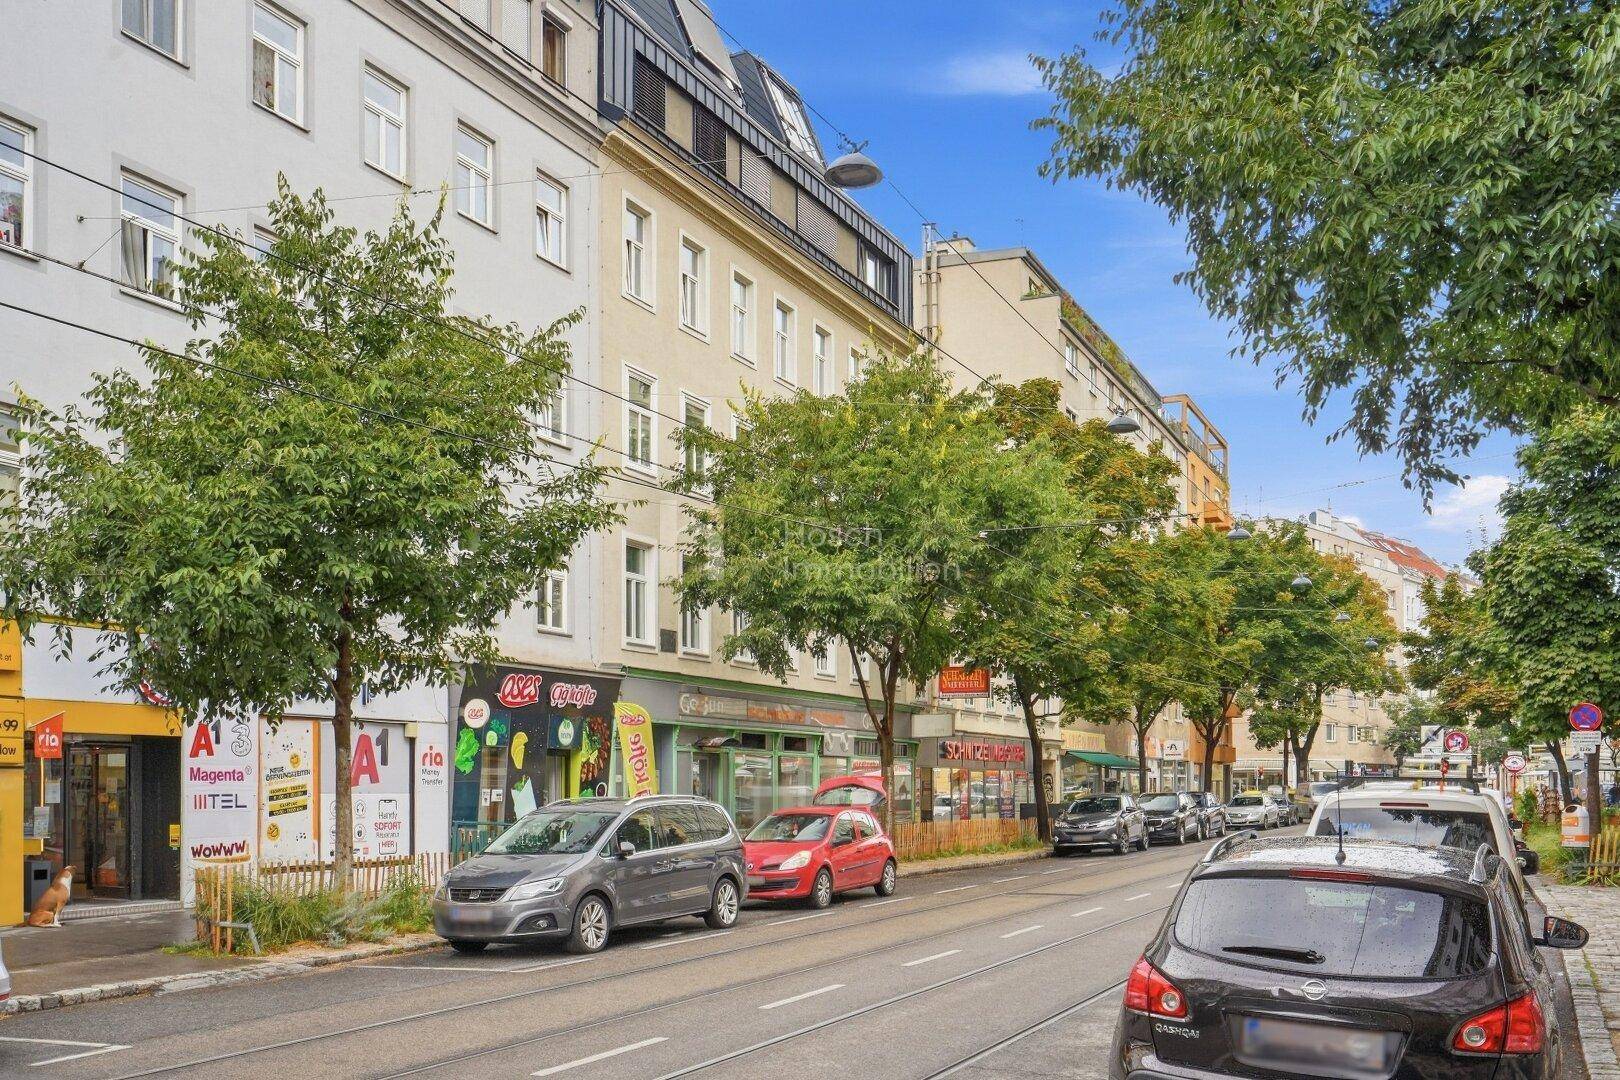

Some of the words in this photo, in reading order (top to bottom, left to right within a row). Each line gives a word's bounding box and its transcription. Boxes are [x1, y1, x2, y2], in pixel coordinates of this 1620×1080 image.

[38, 727, 59, 746] ria
[190, 720, 221, 758] A1
[230, 723, 252, 757] 3
[351, 728, 388, 787] A1
[421, 745, 443, 766] ria
[189, 767, 245, 784] Magenta
[374, 822, 401, 831] SOFORT
